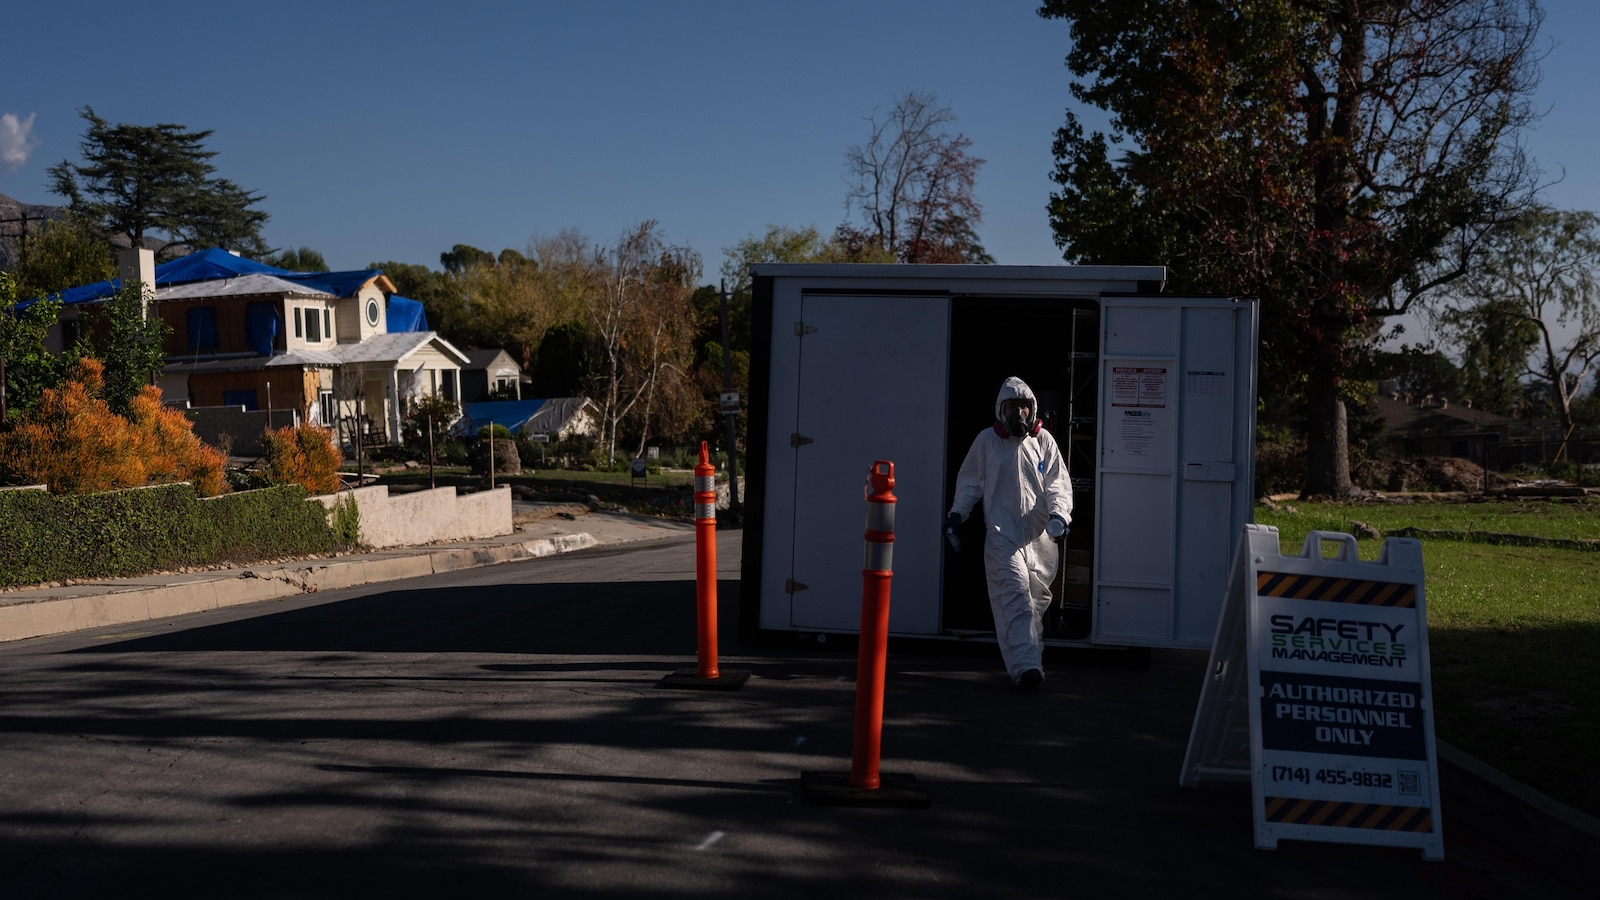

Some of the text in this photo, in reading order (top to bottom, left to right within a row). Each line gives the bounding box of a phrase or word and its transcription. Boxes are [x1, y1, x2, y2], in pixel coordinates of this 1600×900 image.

[1271, 615, 1404, 643] SAFETY
[1272, 634, 1405, 656] SERVICES
[1272, 647, 1407, 668] MANAGEMENT
[1269, 682, 1416, 709] AUTHORIZED
[1275, 703, 1412, 729] PERSONNEL
[1315, 726, 1375, 746] ONLY
[1272, 766, 1392, 788] (714) 455-9832
